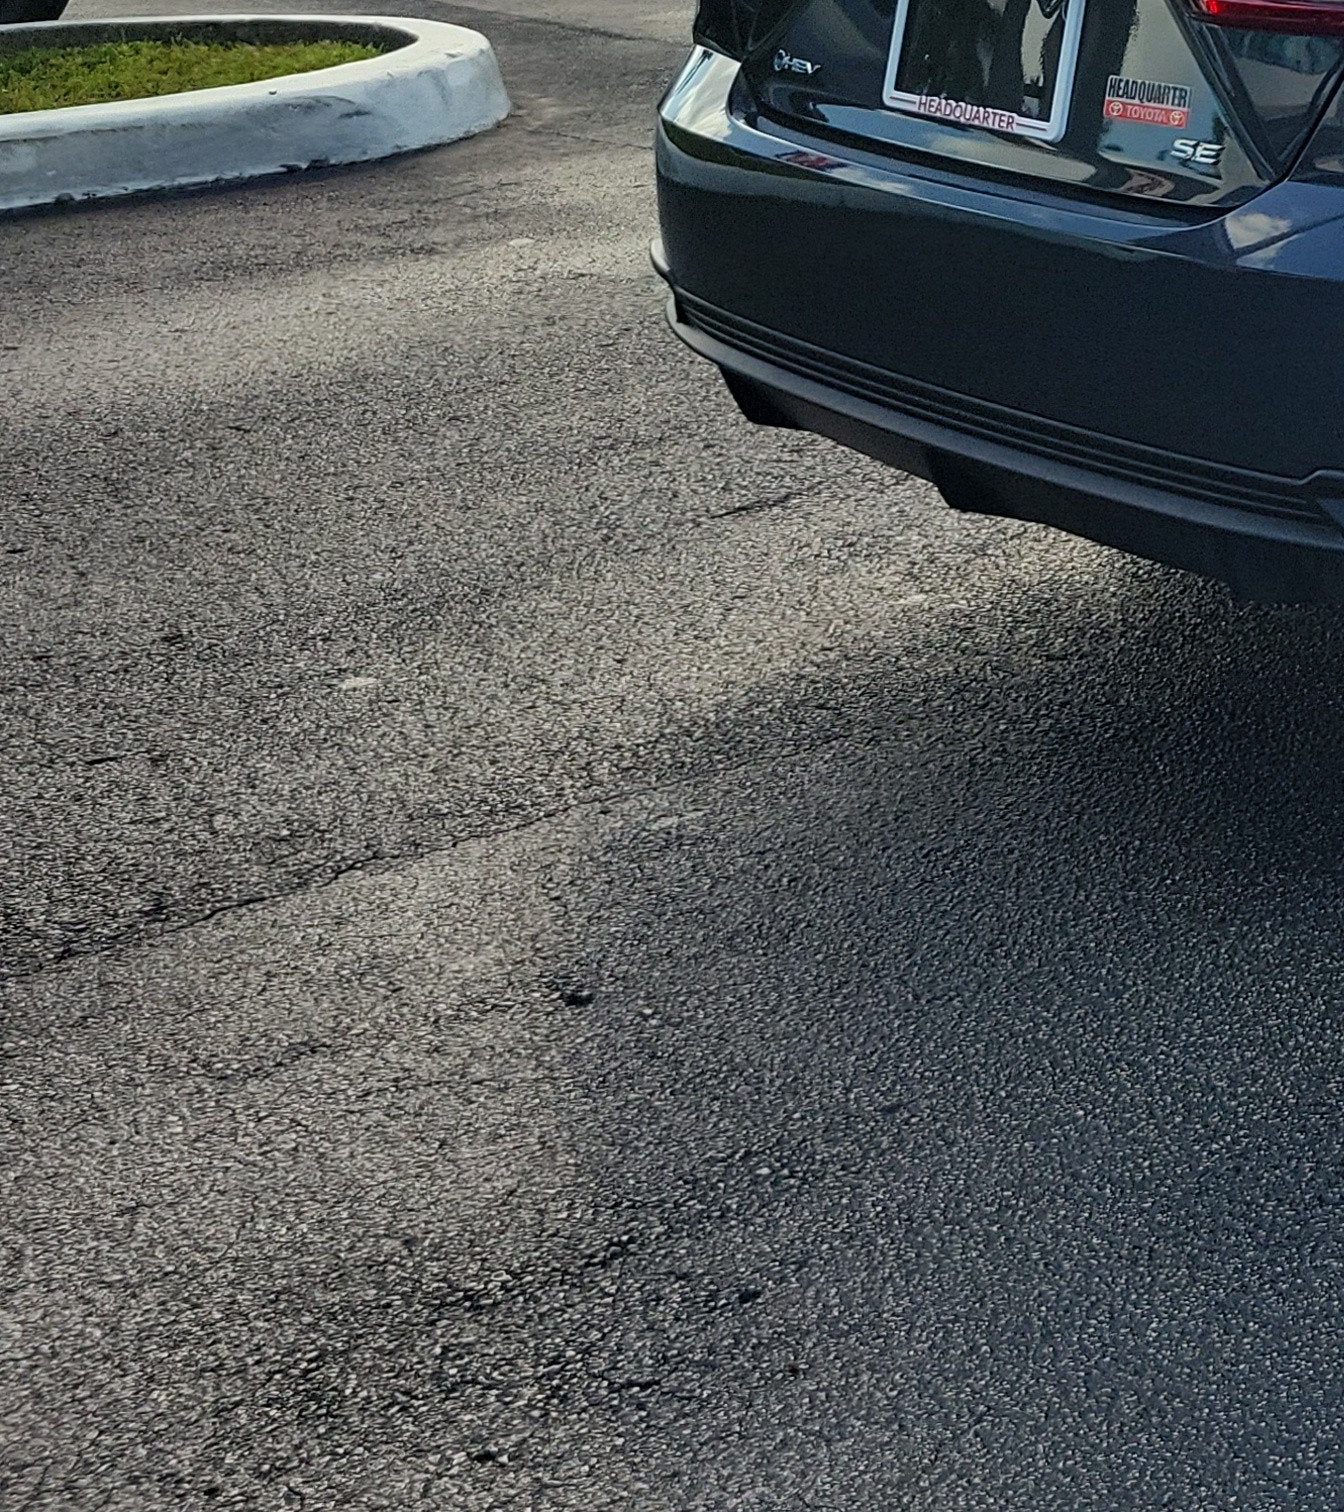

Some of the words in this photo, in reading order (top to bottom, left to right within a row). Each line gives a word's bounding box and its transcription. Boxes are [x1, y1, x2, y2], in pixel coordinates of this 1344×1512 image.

[783, 54, 821, 74] HEV
[1108, 77, 1188, 108] HEADQUARTER
[917, 95, 1016, 131] HEADQUARTER
[1126, 105, 1168, 123] TOYOTA
[1170, 139, 1225, 166] SE
